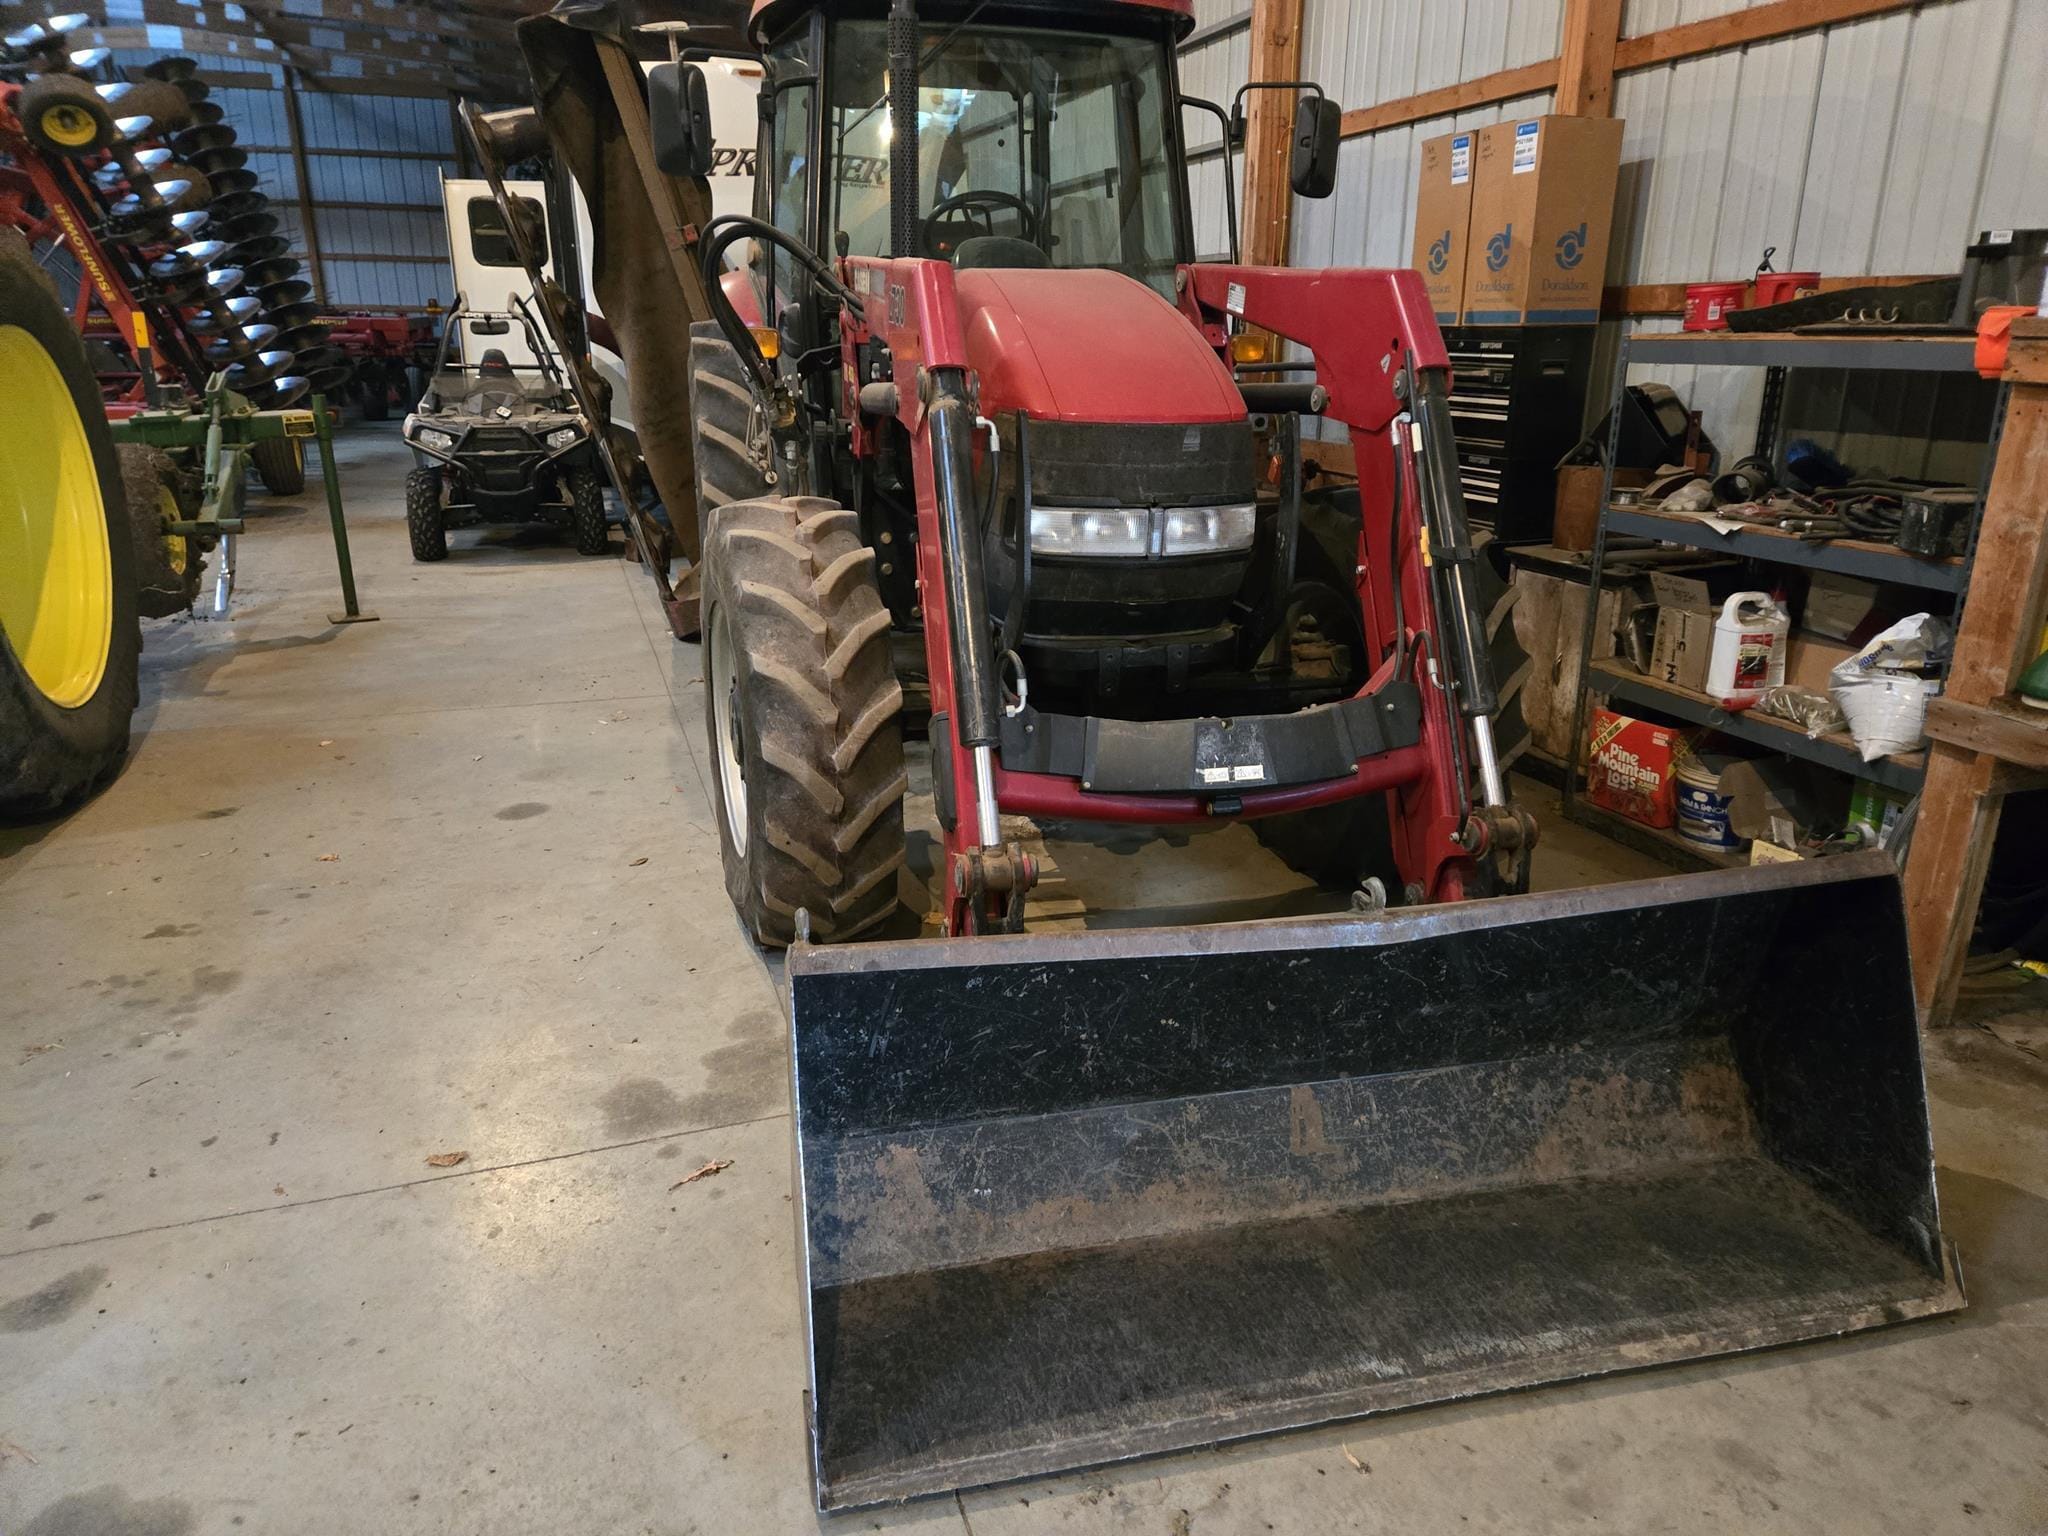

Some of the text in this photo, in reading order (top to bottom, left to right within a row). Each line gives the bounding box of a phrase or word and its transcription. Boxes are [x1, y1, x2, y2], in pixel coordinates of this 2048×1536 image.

[54, 203, 110, 292] SUNFLOWER
[1475, 279, 1515, 293] Donaldson
[1542, 277, 1589, 291] Donaldson
[465, 311, 513, 319] POLRIS
[1610, 742, 1639, 766] Pine
[1598, 750, 1660, 785] Mountain
[1607, 770, 1636, 791] Logs
